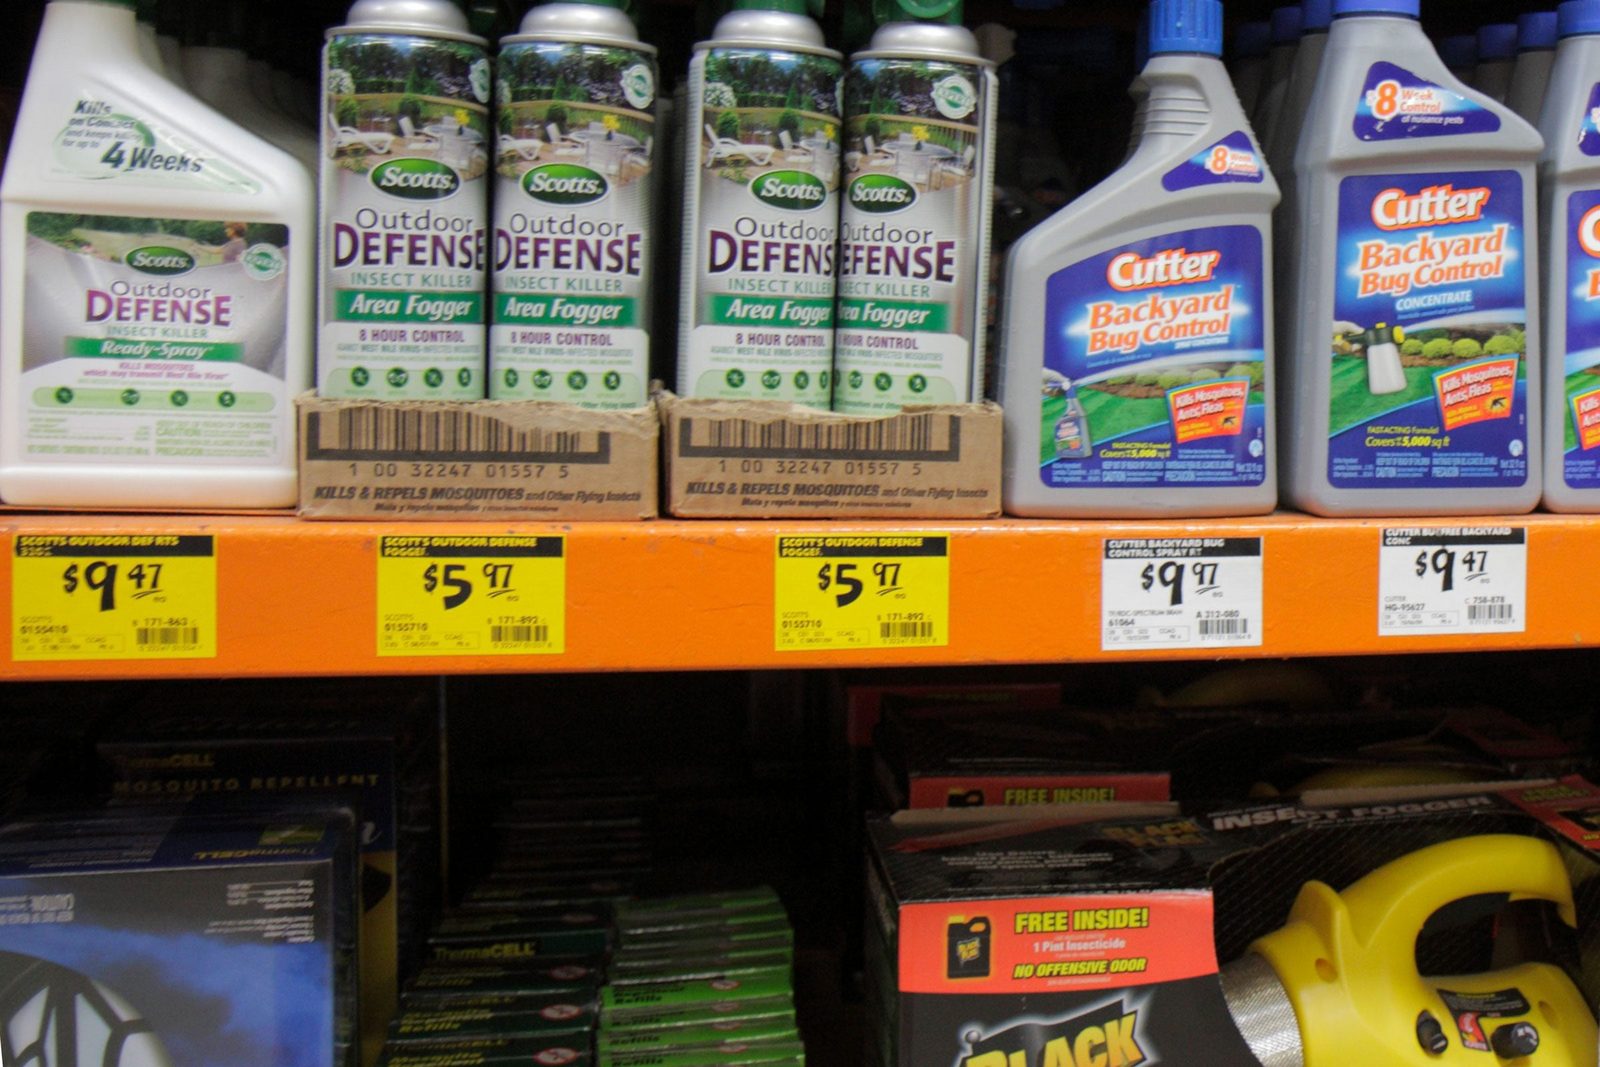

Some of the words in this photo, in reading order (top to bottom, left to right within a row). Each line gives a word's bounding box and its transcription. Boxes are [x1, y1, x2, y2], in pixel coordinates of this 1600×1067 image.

[1374, 81, 1399, 116] 8
[1400, 102, 1441, 113] Control
[101, 141, 125, 169] 4
[129, 147, 205, 173] Weeks
[1211, 146, 1228, 173] 8
[380, 166, 453, 190] Scotts
[530, 173, 600, 194] Scotts
[760, 178, 823, 200] Scotts
[852, 183, 908, 203] Scotts
[1372, 185, 1489, 229] Cutter
[356, 208, 473, 233] Outdoor
[510, 213, 624, 238] Outdoor
[841, 222, 933, 244] Outdoor
[333, 223, 487, 272] DEFENSE
[495, 228, 641, 276] DEFENSE
[708, 230, 835, 277] DEFENS
[1357, 224, 1507, 271] Backyard
[134, 251, 188, 270] Scotts
[842, 240, 955, 283] EFENSE
[1108, 249, 1219, 290] Cutter
[351, 272, 415, 287] INSECT
[421, 273, 473, 289] KILLER
[505, 276, 559, 290] INSECT
[565, 277, 623, 292] KILLER
[728, 278, 789, 293] INSECT
[1358, 271, 1410, 298] Bug
[1413, 254, 1504, 287] Control
[110, 280, 212, 300] Outdoor
[875, 283, 931, 298] KILLER
[1396, 290, 1473, 311] CONCENTRATE
[85, 289, 232, 327] DEFENSE
[349, 293, 401, 314] Area
[404, 295, 473, 321] Fogger
[504, 296, 547, 318] Area
[550, 298, 623, 325] Fogger
[725, 298, 776, 320] Area
[779, 301, 832, 327] Fogger
[862, 302, 931, 328] Fogger
[1087, 283, 1235, 330] Backyard
[107, 325, 156, 338] INSECT
[161, 326, 209, 339] KILLER
[359, 329, 367, 342] 8
[371, 330, 407, 342] HOUR
[412, 330, 466, 343] CONTROL
[520, 332, 551, 345] HOUR
[556, 333, 614, 346] CONTROL
[735, 333, 744, 345] 8
[748, 333, 781, 346] HOUR
[785, 334, 826, 347] CONTROL
[867, 336, 919, 350] CONTROL
[1087, 329, 1139, 355] Bug
[1143, 313, 1230, 344] Control
[1365, 436, 1396, 447] Covers
[1402, 436, 1431, 447] 5,000
[350, 463, 358, 477] 1
[374, 464, 397, 477] 00
[412, 463, 472, 478] 32247
[486, 465, 545, 479] 01557
[558, 465, 569, 479] 5
[719, 460, 726, 473] 1
[741, 460, 763, 474] 00
[777, 460, 831, 474] 32247
[845, 461, 899, 476] 01557
[913, 462, 922, 476] 5
[314, 486, 355, 500] KILLS
[359, 487, 370, 500] &
[374, 487, 428, 500] REPELS
[431, 487, 525, 502] MOSQUITOES
[685, 482, 725, 495] KILLS
[727, 482, 738, 495] &
[740, 482, 790, 496] REPELS
[793, 483, 880, 498] MOSQUITOES
[68, 536, 130, 547] OUTDOOR
[431, 537, 489, 547] OUTDOOR
[489, 537, 537, 547] DEFENSE
[825, 538, 878, 548] OUTDOOR
[878, 537, 923, 547] DEFENSE
[1385, 528, 1421, 537] CUTTER
[1462, 527, 1512, 536] BACKYARD
[1385, 537, 1412, 546] CONC
[1107, 539, 1147, 549] CUTTER
[1147, 539, 1202, 549] BACKYARD
[1203, 538, 1225, 548] BUG
[1107, 548, 1155, 558] CONTROL
[1156, 548, 1189, 557] SPRAY
[1462, 550, 1489, 572] 47
[128, 563, 164, 590] 47
[483, 563, 514, 589] 97
[873, 562, 901, 587] 97
[1192, 562, 1219, 586] 97
[112, 776, 239, 794] MOSQUITO
[250, 774, 381, 792] REPELLENT
[1004, 788, 1049, 805] FREE
[1053, 787, 1116, 804] INSIDE!
[1212, 806, 1341, 832] INSECT
[1351, 795, 1492, 816] FOGGER
[1015, 911, 1069, 934] FREE
[1073, 907, 1150, 932] INSIDE!
[1033, 941, 1039, 953] 1
[1042, 940, 1065, 952] Pint
[1066, 938, 1126, 951] Insecticide
[1014, 963, 1033, 979] NO
[1036, 960, 1107, 977] OFFENSIVE
[1109, 957, 1148, 973] ODOR
